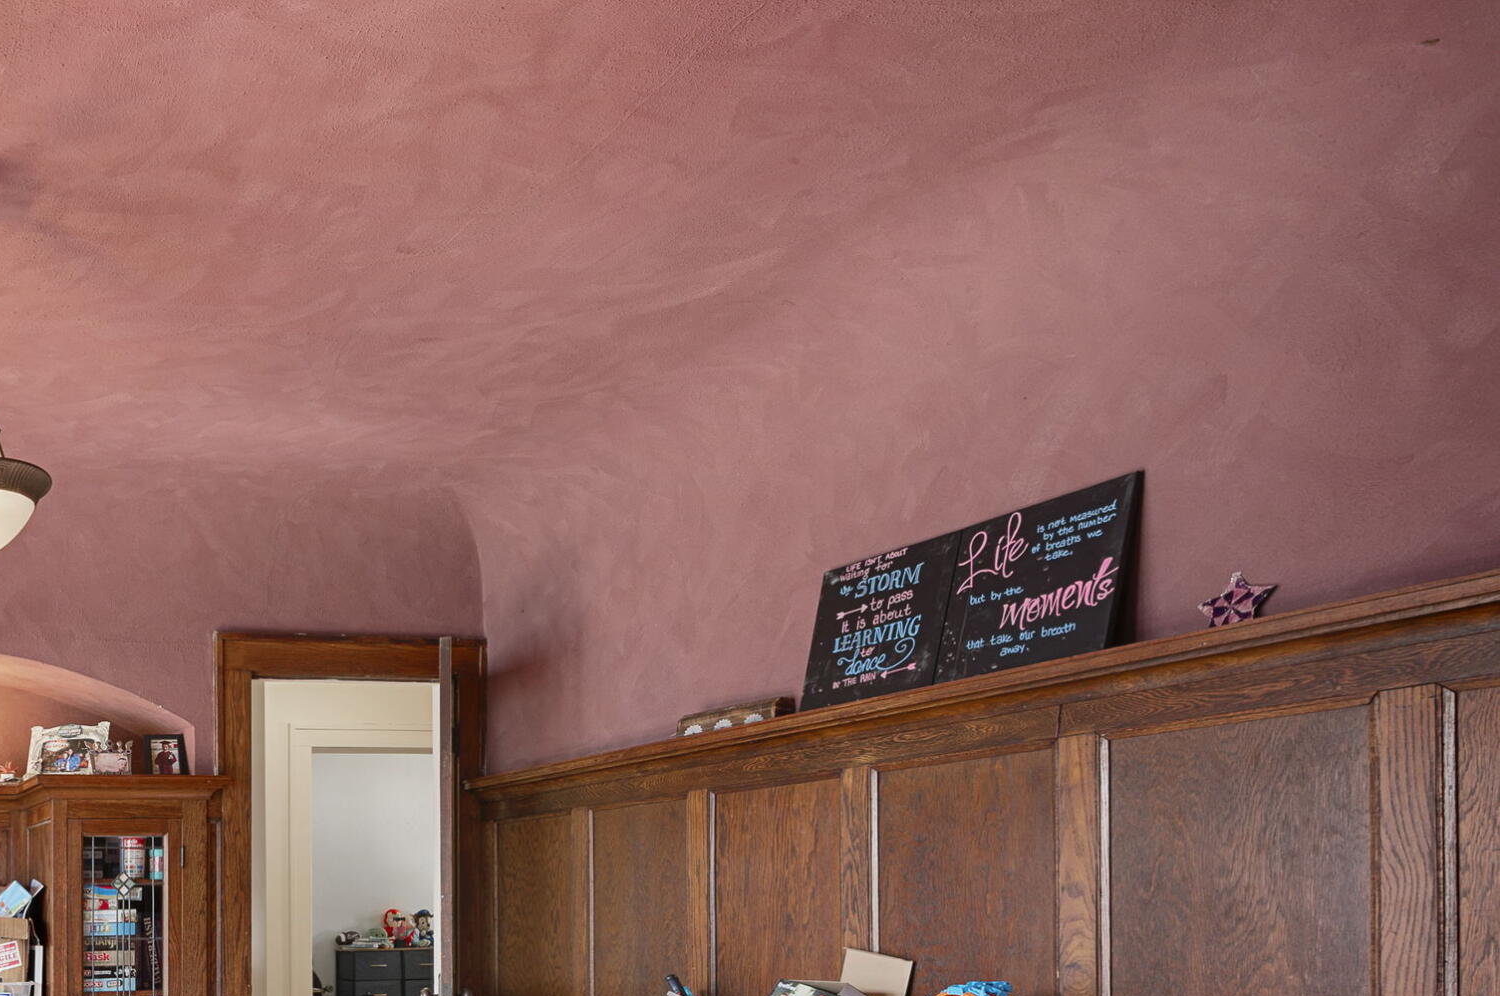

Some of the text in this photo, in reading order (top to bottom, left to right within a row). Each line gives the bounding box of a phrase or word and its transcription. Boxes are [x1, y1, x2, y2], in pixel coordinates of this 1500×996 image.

[1036, 524, 1044, 533] is
[1047, 515, 1067, 530] not
[1043, 512, 1117, 541] by the number
[957, 511, 1029, 595] Life
[1031, 529, 1103, 554] of breaths we
[840, 560, 893, 581] waiting for
[846, 562, 861, 573] LIFE
[854, 562, 924, 599] STORM
[870, 589, 914, 611] to pass
[969, 585, 1024, 606] but by the
[841, 603, 912, 633] It is about
[832, 614, 922, 654] LEARNING
[965, 622, 1076, 651] that take our breath
[860, 646, 875, 657] to
[844, 677, 857, 686] THE
